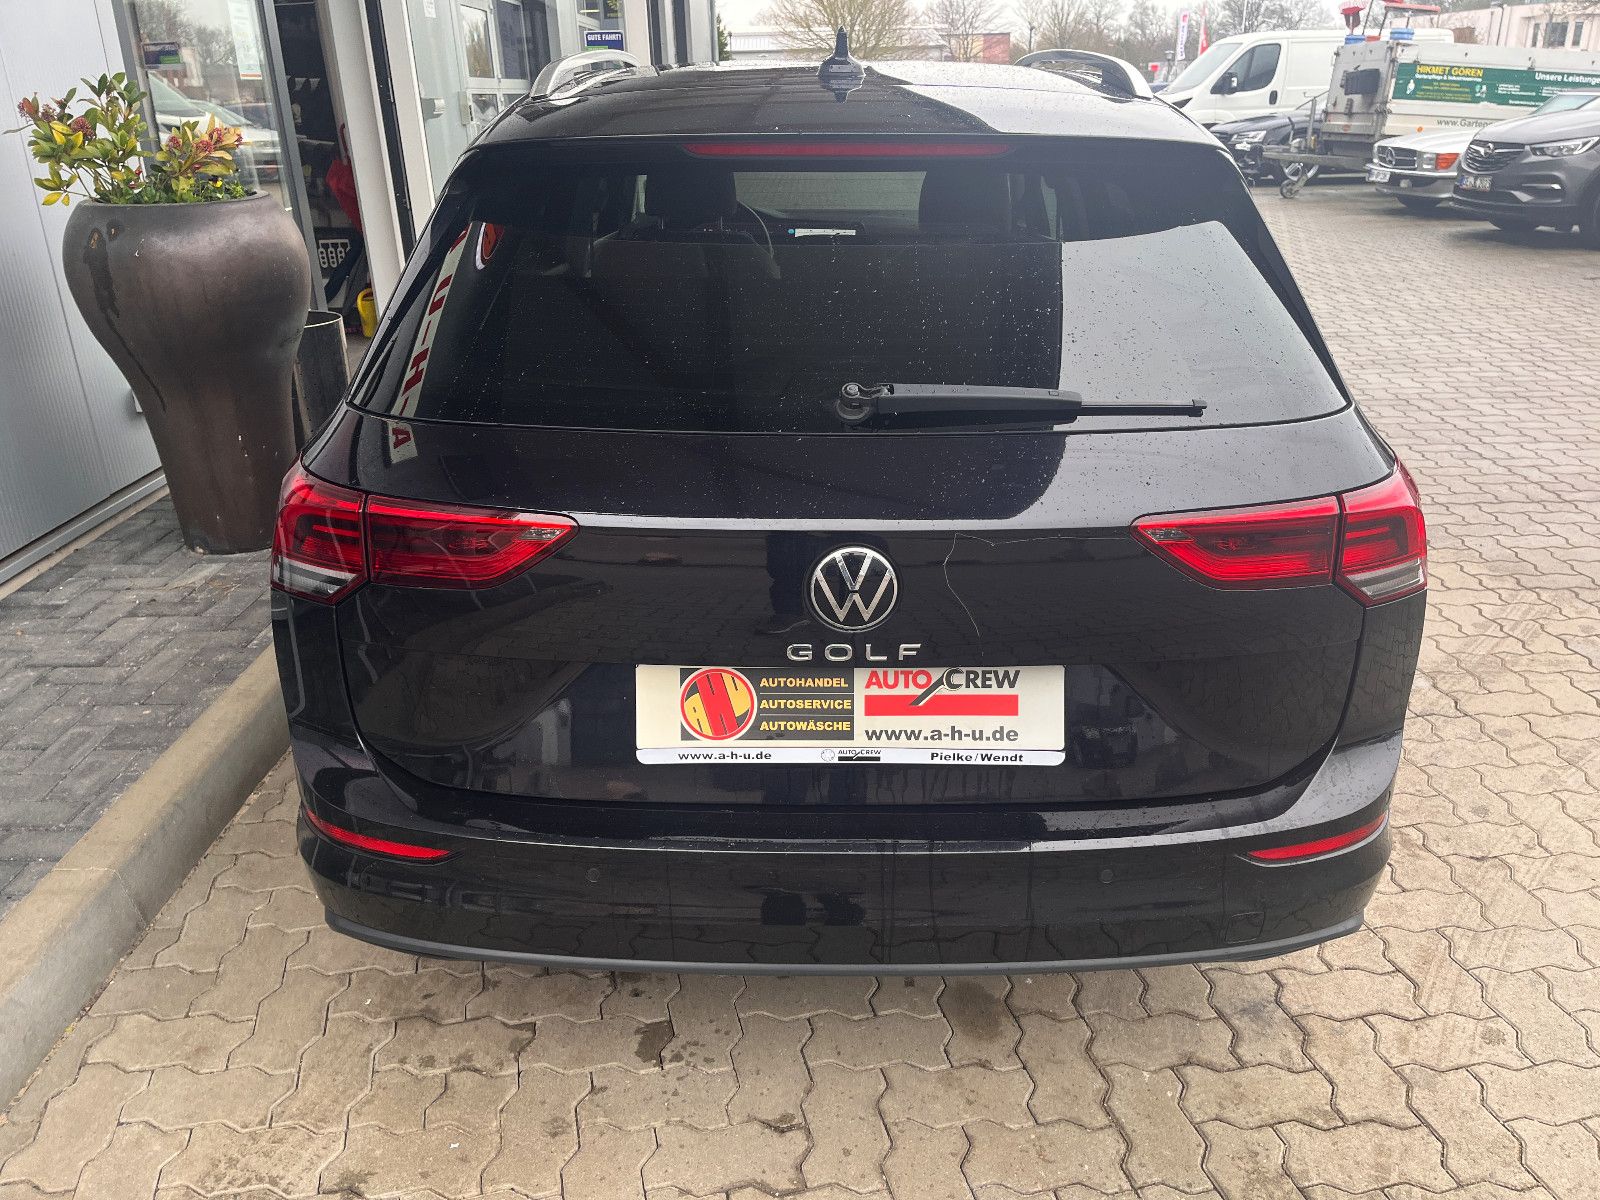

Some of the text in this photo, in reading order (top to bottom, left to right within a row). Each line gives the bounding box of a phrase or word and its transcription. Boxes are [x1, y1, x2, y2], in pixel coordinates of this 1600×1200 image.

[1416, 65, 1450, 75] HIKMET
[1535, 72, 1563, 81] Unsere
[786, 643, 922, 661] GOLF
[759, 677, 849, 688] AUTOHANDEL
[865, 667, 1021, 690] AUTO CREW
[759, 699, 852, 710] AUTOSERVICE
[759, 719, 851, 731] AUTOWÄSCHE
[865, 725, 1019, 742] www.a-h-u.de
[677, 751, 772, 761] www.a-h-u.de
[930, 752, 1024, 763] Pielke/Wendt
